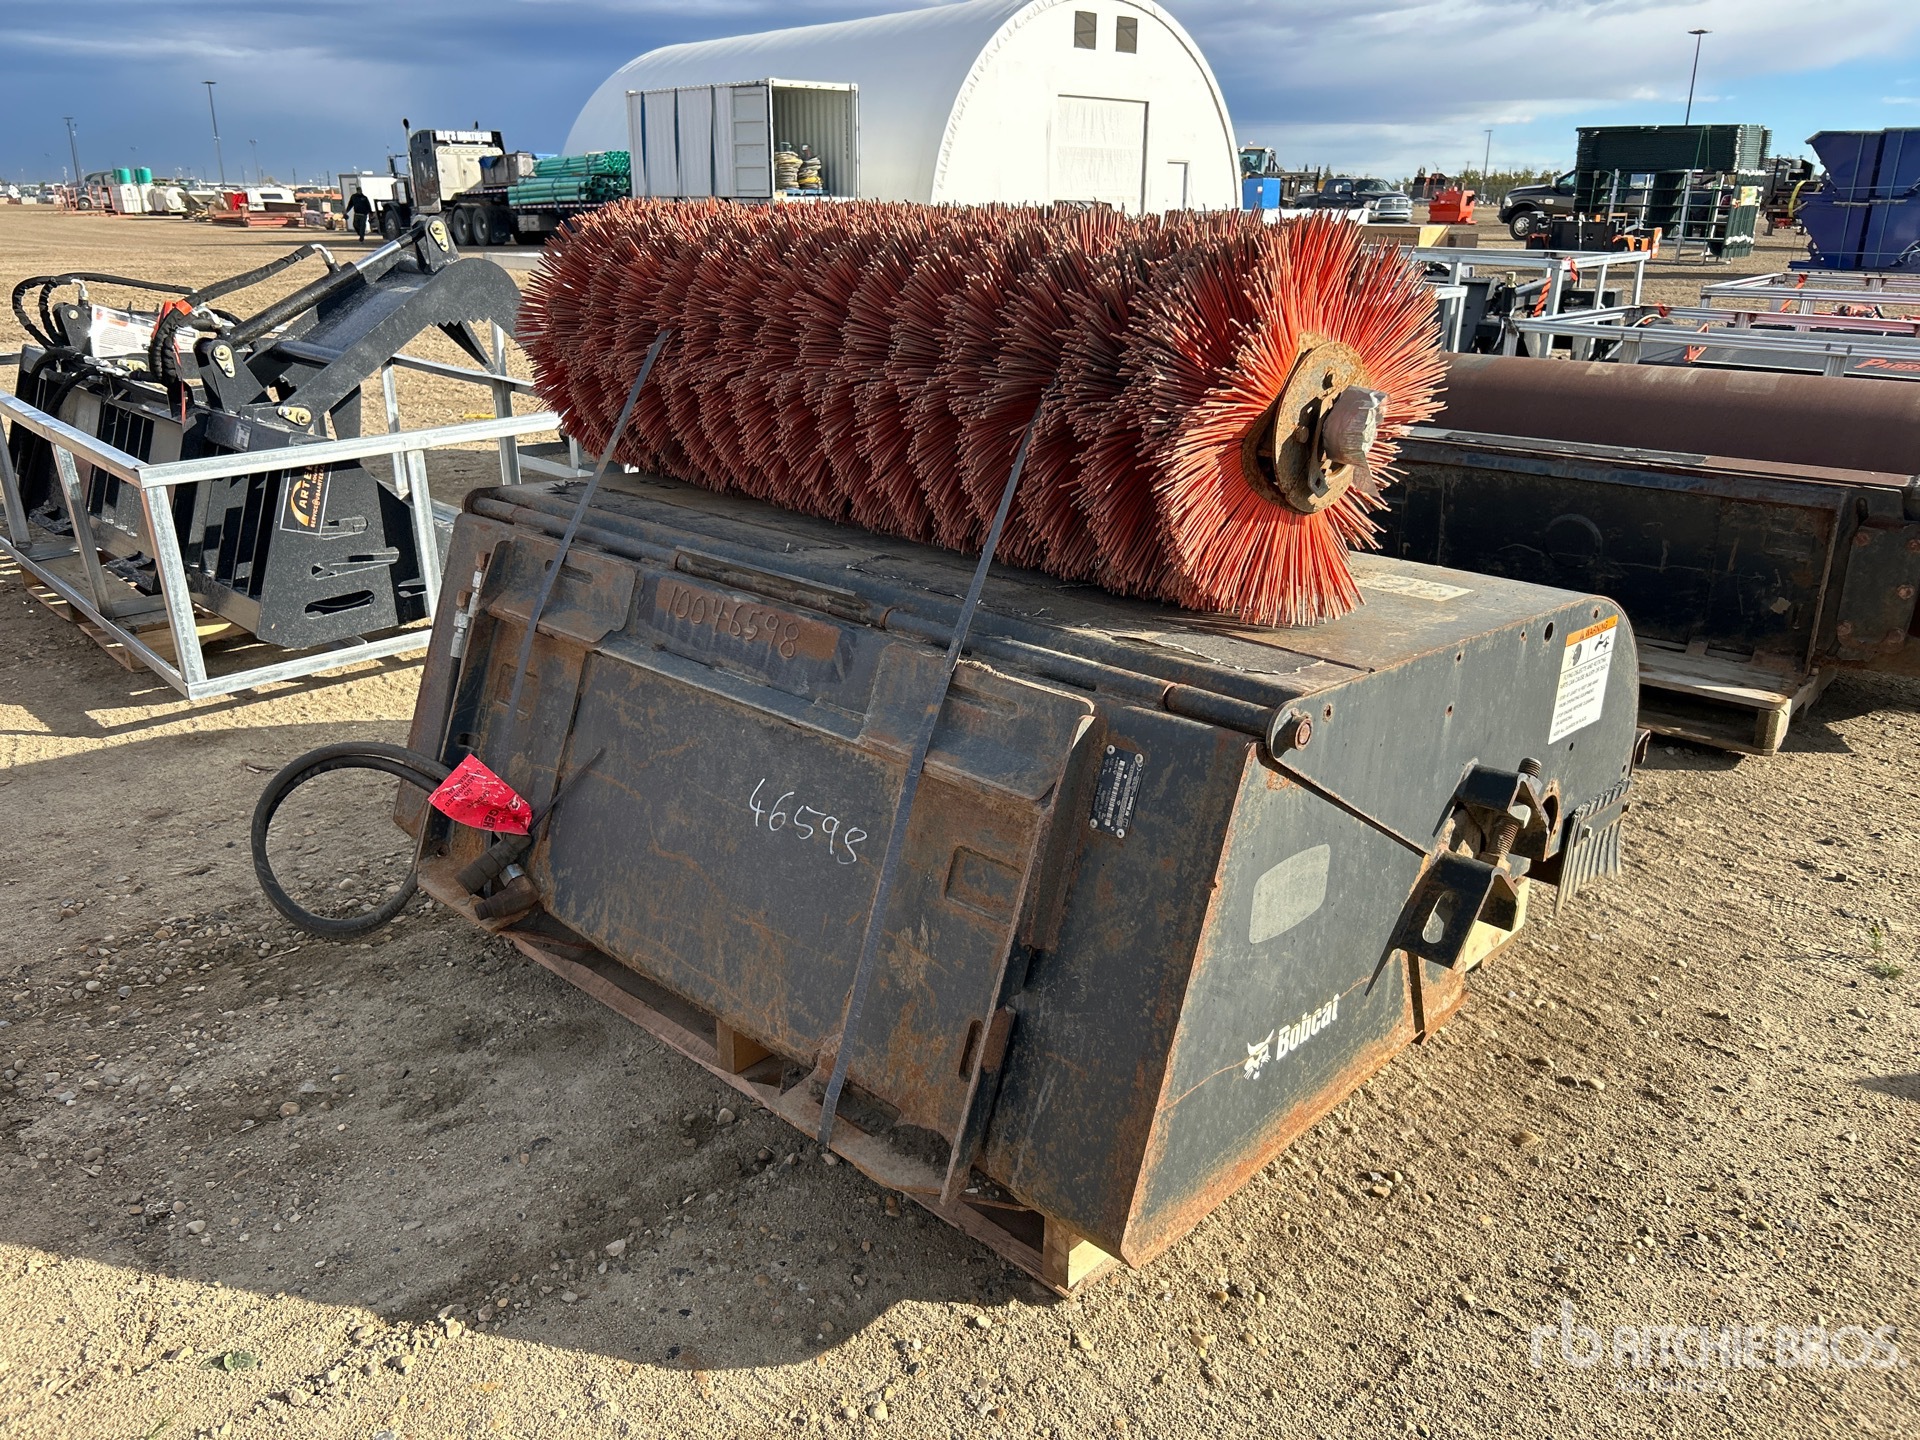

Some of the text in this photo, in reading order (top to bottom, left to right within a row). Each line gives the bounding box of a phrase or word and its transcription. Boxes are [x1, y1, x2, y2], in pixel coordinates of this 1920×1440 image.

[665, 585, 801, 659] 10046598
[445, 769, 481, 807] UAUTHORIZED
[749, 777, 868, 865] 46598
[1276, 993, 1341, 1061] Bobcat
